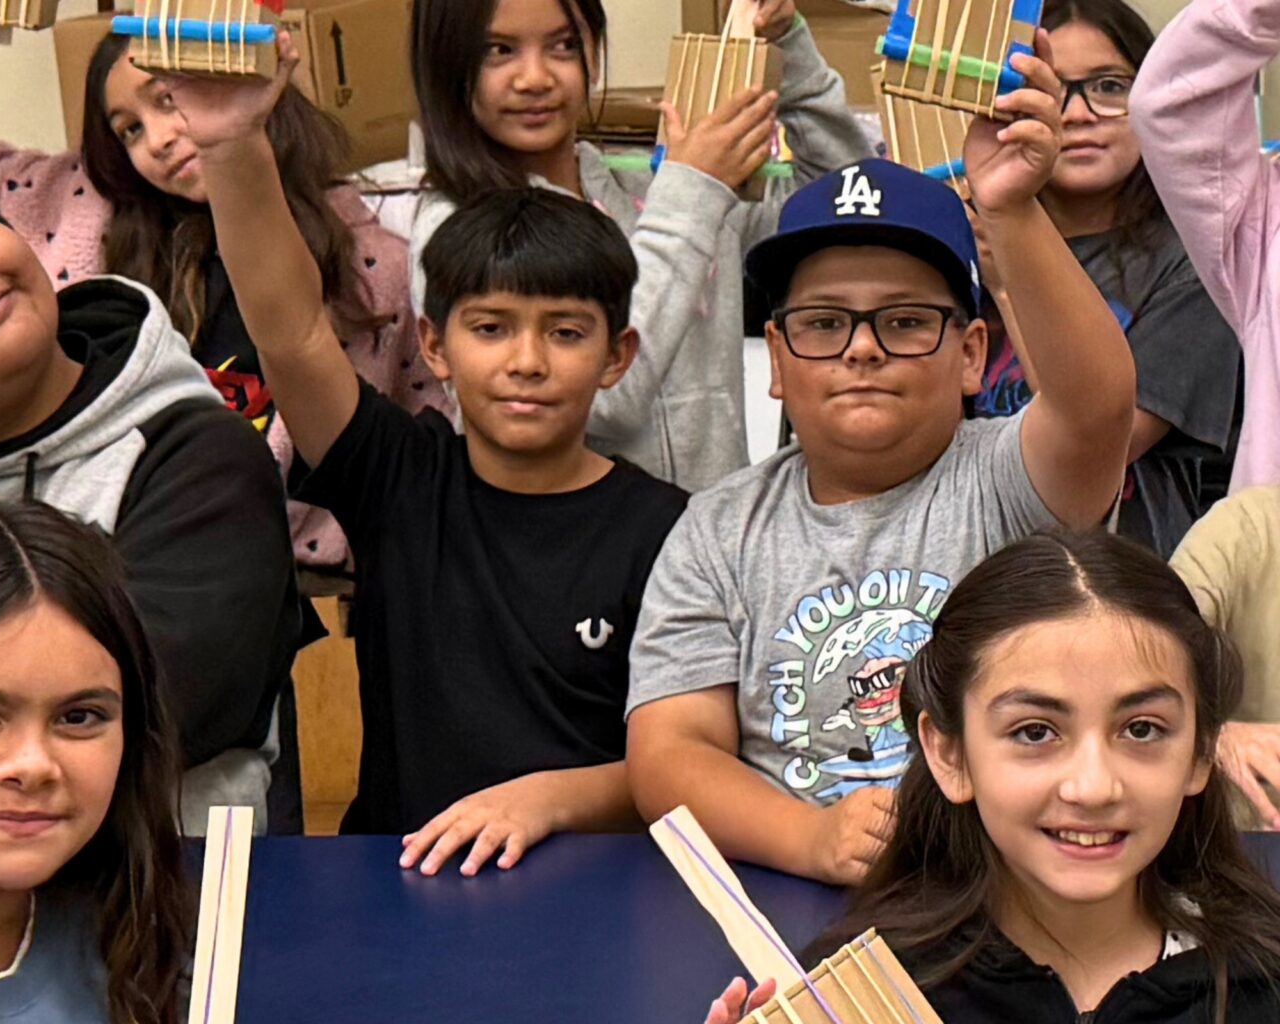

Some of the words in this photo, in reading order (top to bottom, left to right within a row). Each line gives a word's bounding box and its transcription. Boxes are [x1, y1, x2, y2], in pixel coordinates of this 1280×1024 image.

[834, 165, 882, 216] LA
[773, 583, 856, 654] YOU
[914, 570, 950, 622] T
